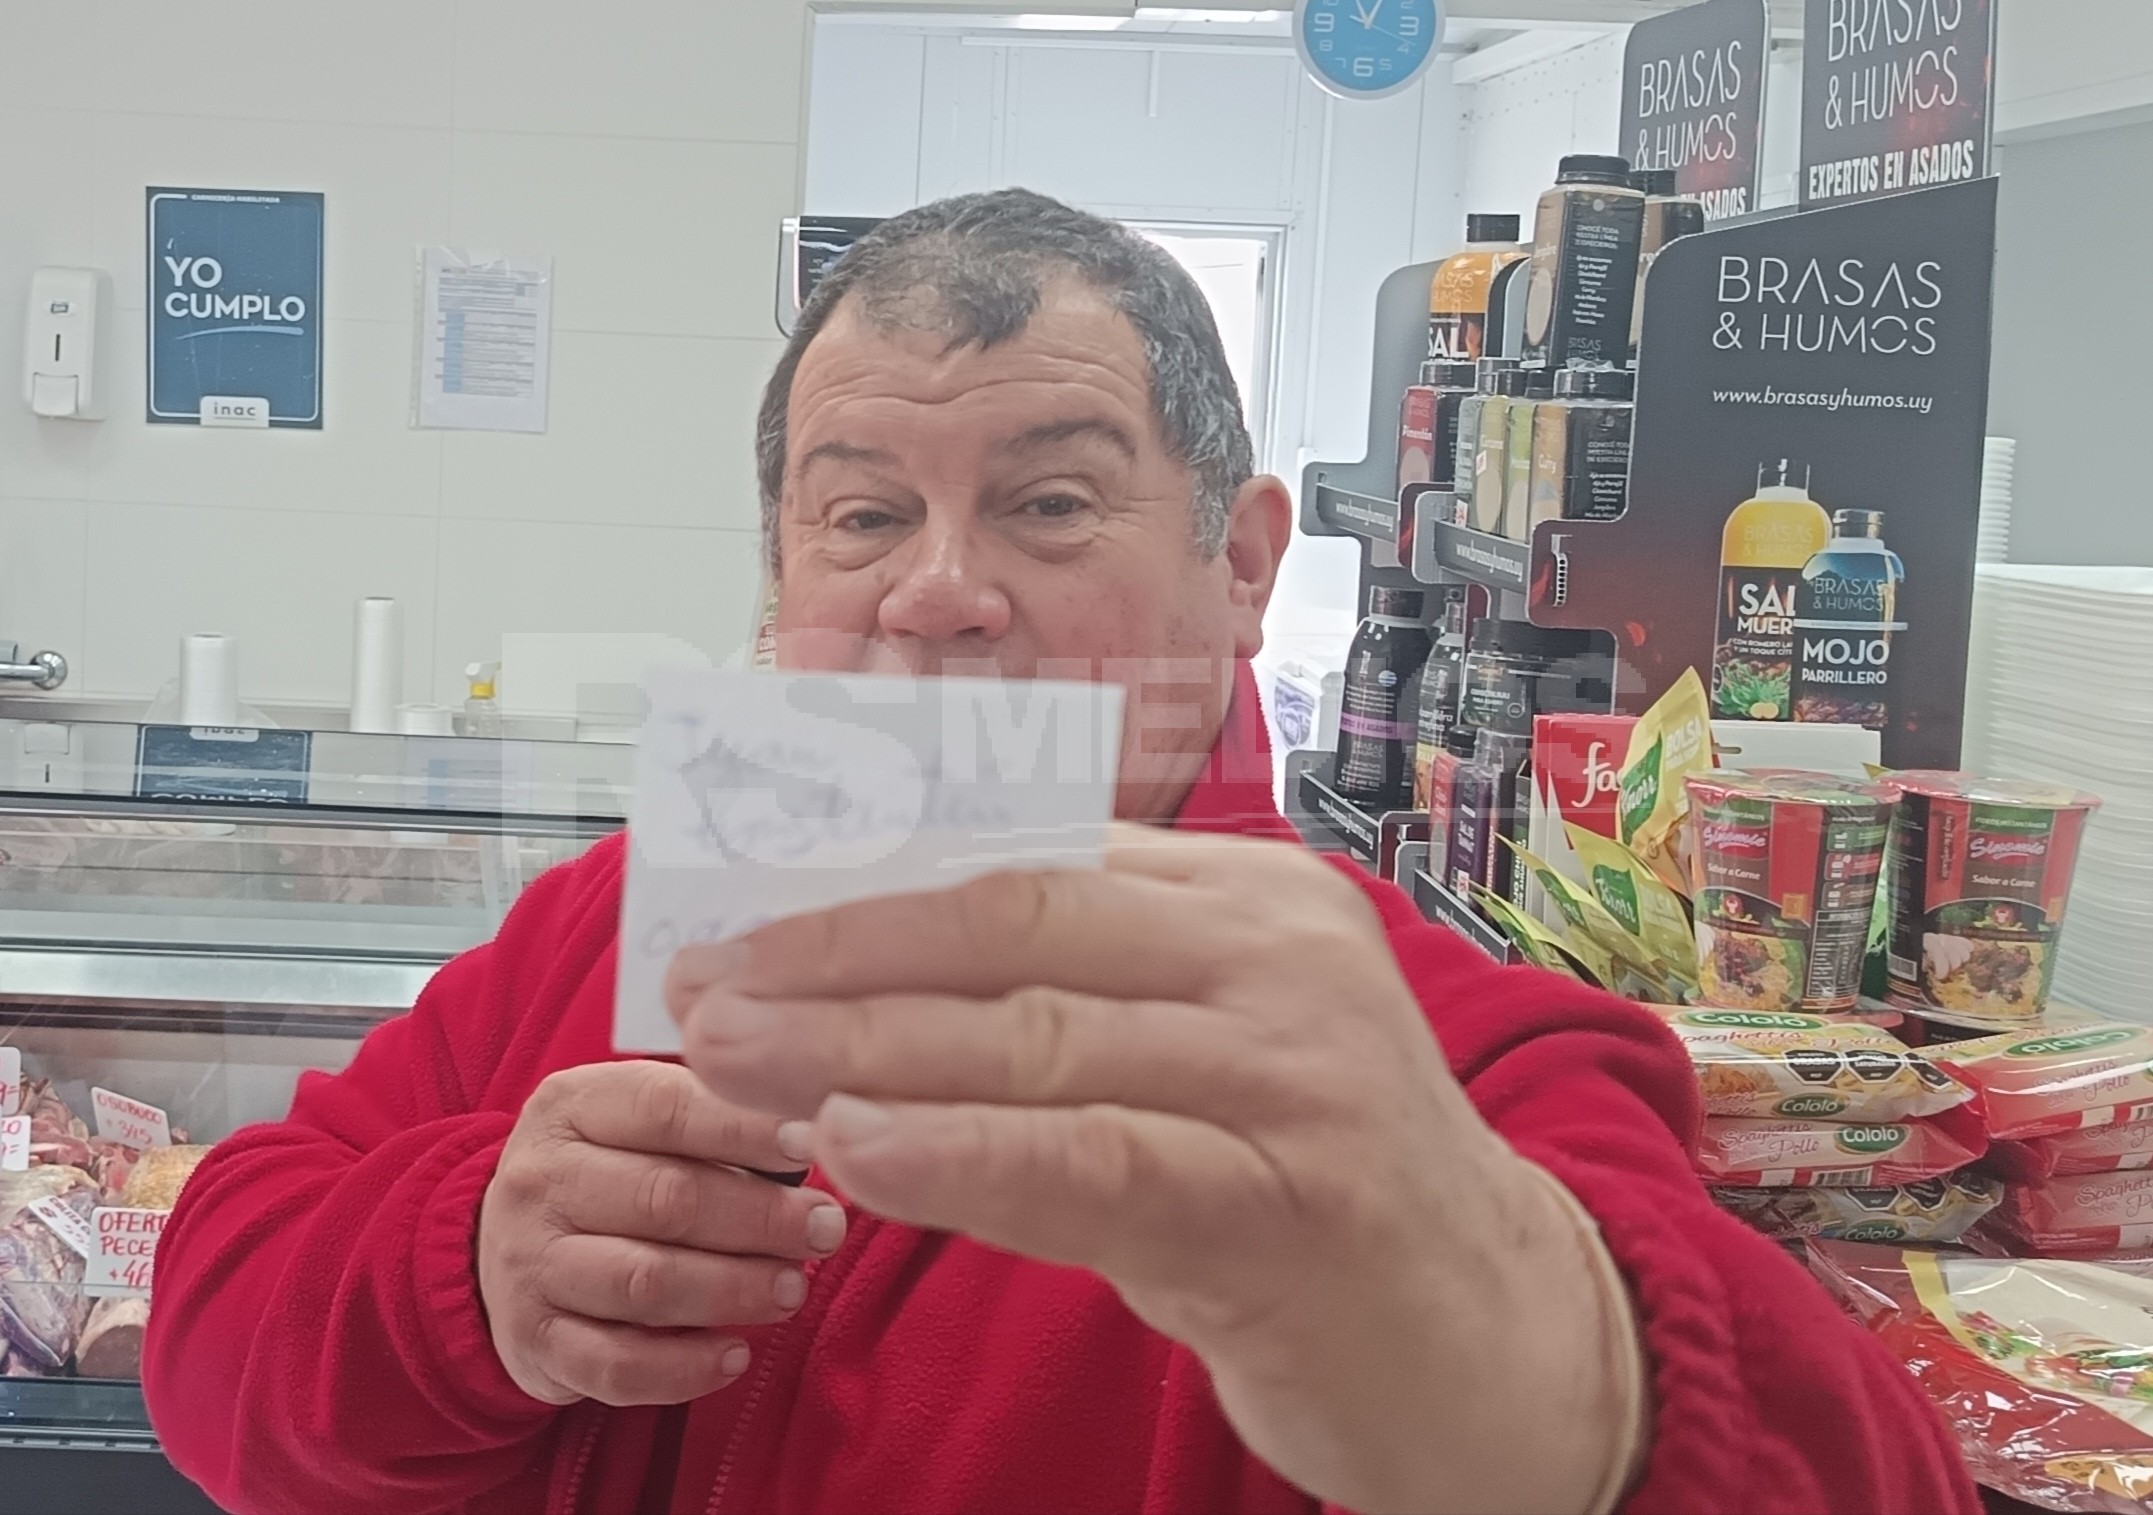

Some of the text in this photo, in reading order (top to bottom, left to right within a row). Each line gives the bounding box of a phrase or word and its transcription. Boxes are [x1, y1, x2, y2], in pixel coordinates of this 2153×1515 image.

[1313, 12, 1420, 36] 9 3
[1353, 57, 1374, 77] 6
[1638, 40, 1742, 118] BRASAS
[1824, 45, 1959, 130] & HUMOS
[1635, 111, 1738, 171] & HUMOS
[1808, 139, 1975, 201] EXPERTOS EN ASADOS
[164, 256, 223, 289] YO
[1717, 256, 1942, 309] BRASAS
[164, 292, 306, 322] CUMPLO
[1711, 311, 1936, 355] & HUMOS
[213, 402, 257, 417] inac
[1712, 385, 1933, 414] www.brasasyhumos.uy
[1813, 577, 1885, 597] BRASAS
[1826, 598, 1885, 612] HUMOS
[1802, 638, 1890, 666] MOJO
[1801, 667, 1888, 685] PARRILLERO
[1734, 868, 1761, 880] Carne
[1971, 874, 2001, 885] Sabor
[2009, 878, 2036, 888] Carne
[1681, 1031, 1803, 1044] paghettis
[1767, 1138, 1821, 1163] Pollo
